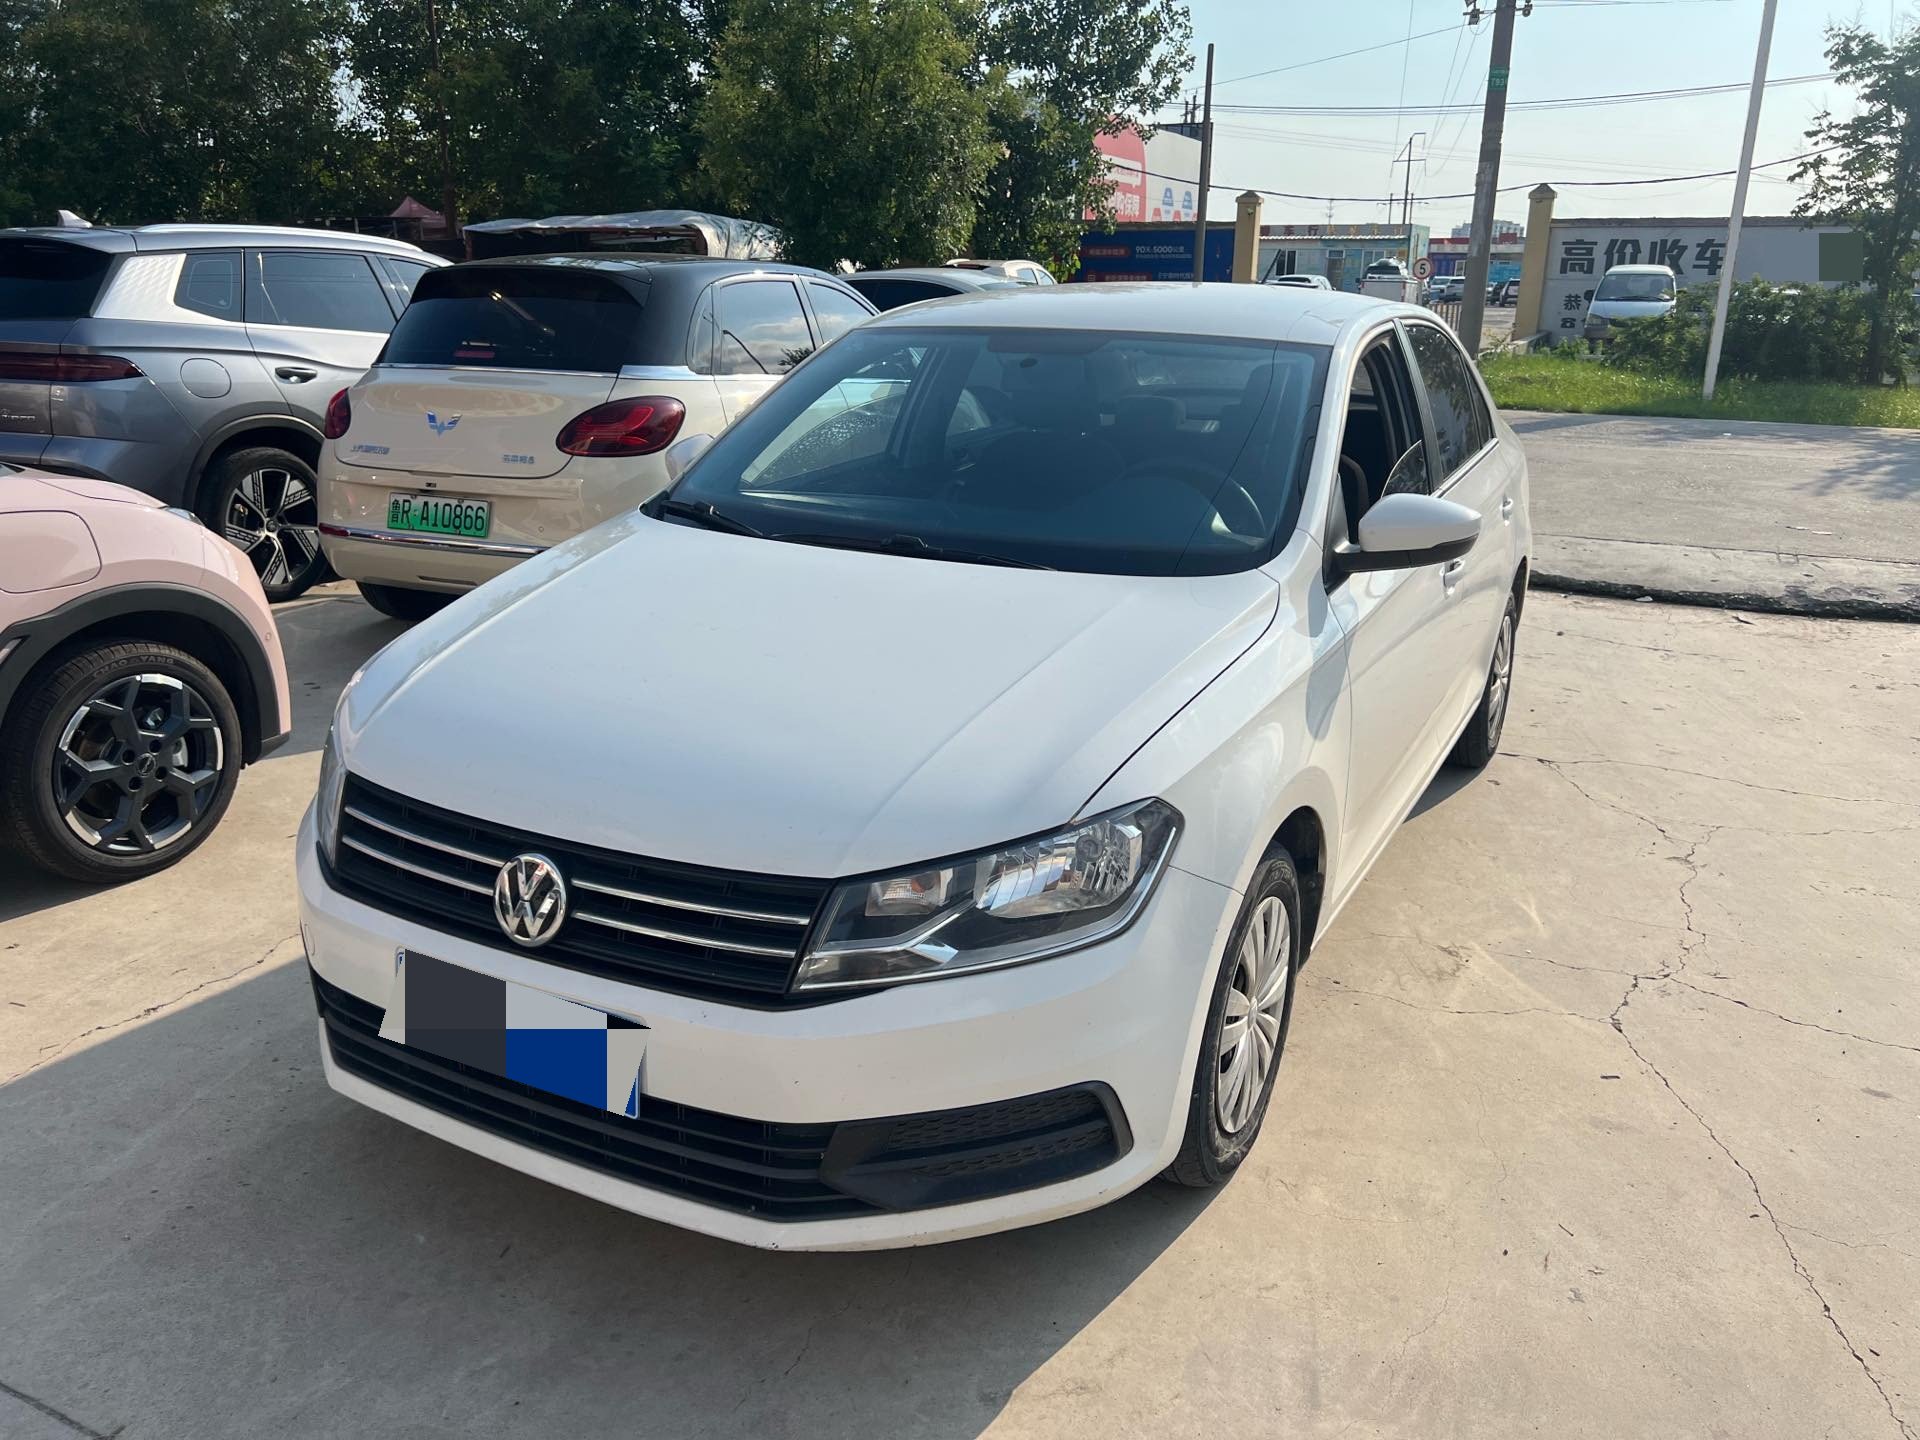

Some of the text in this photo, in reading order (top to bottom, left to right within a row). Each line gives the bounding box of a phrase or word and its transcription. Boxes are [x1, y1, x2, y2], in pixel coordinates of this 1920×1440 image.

[1560, 238, 1727, 275] 高价收车
[1419, 263, 1426, 275] 5
